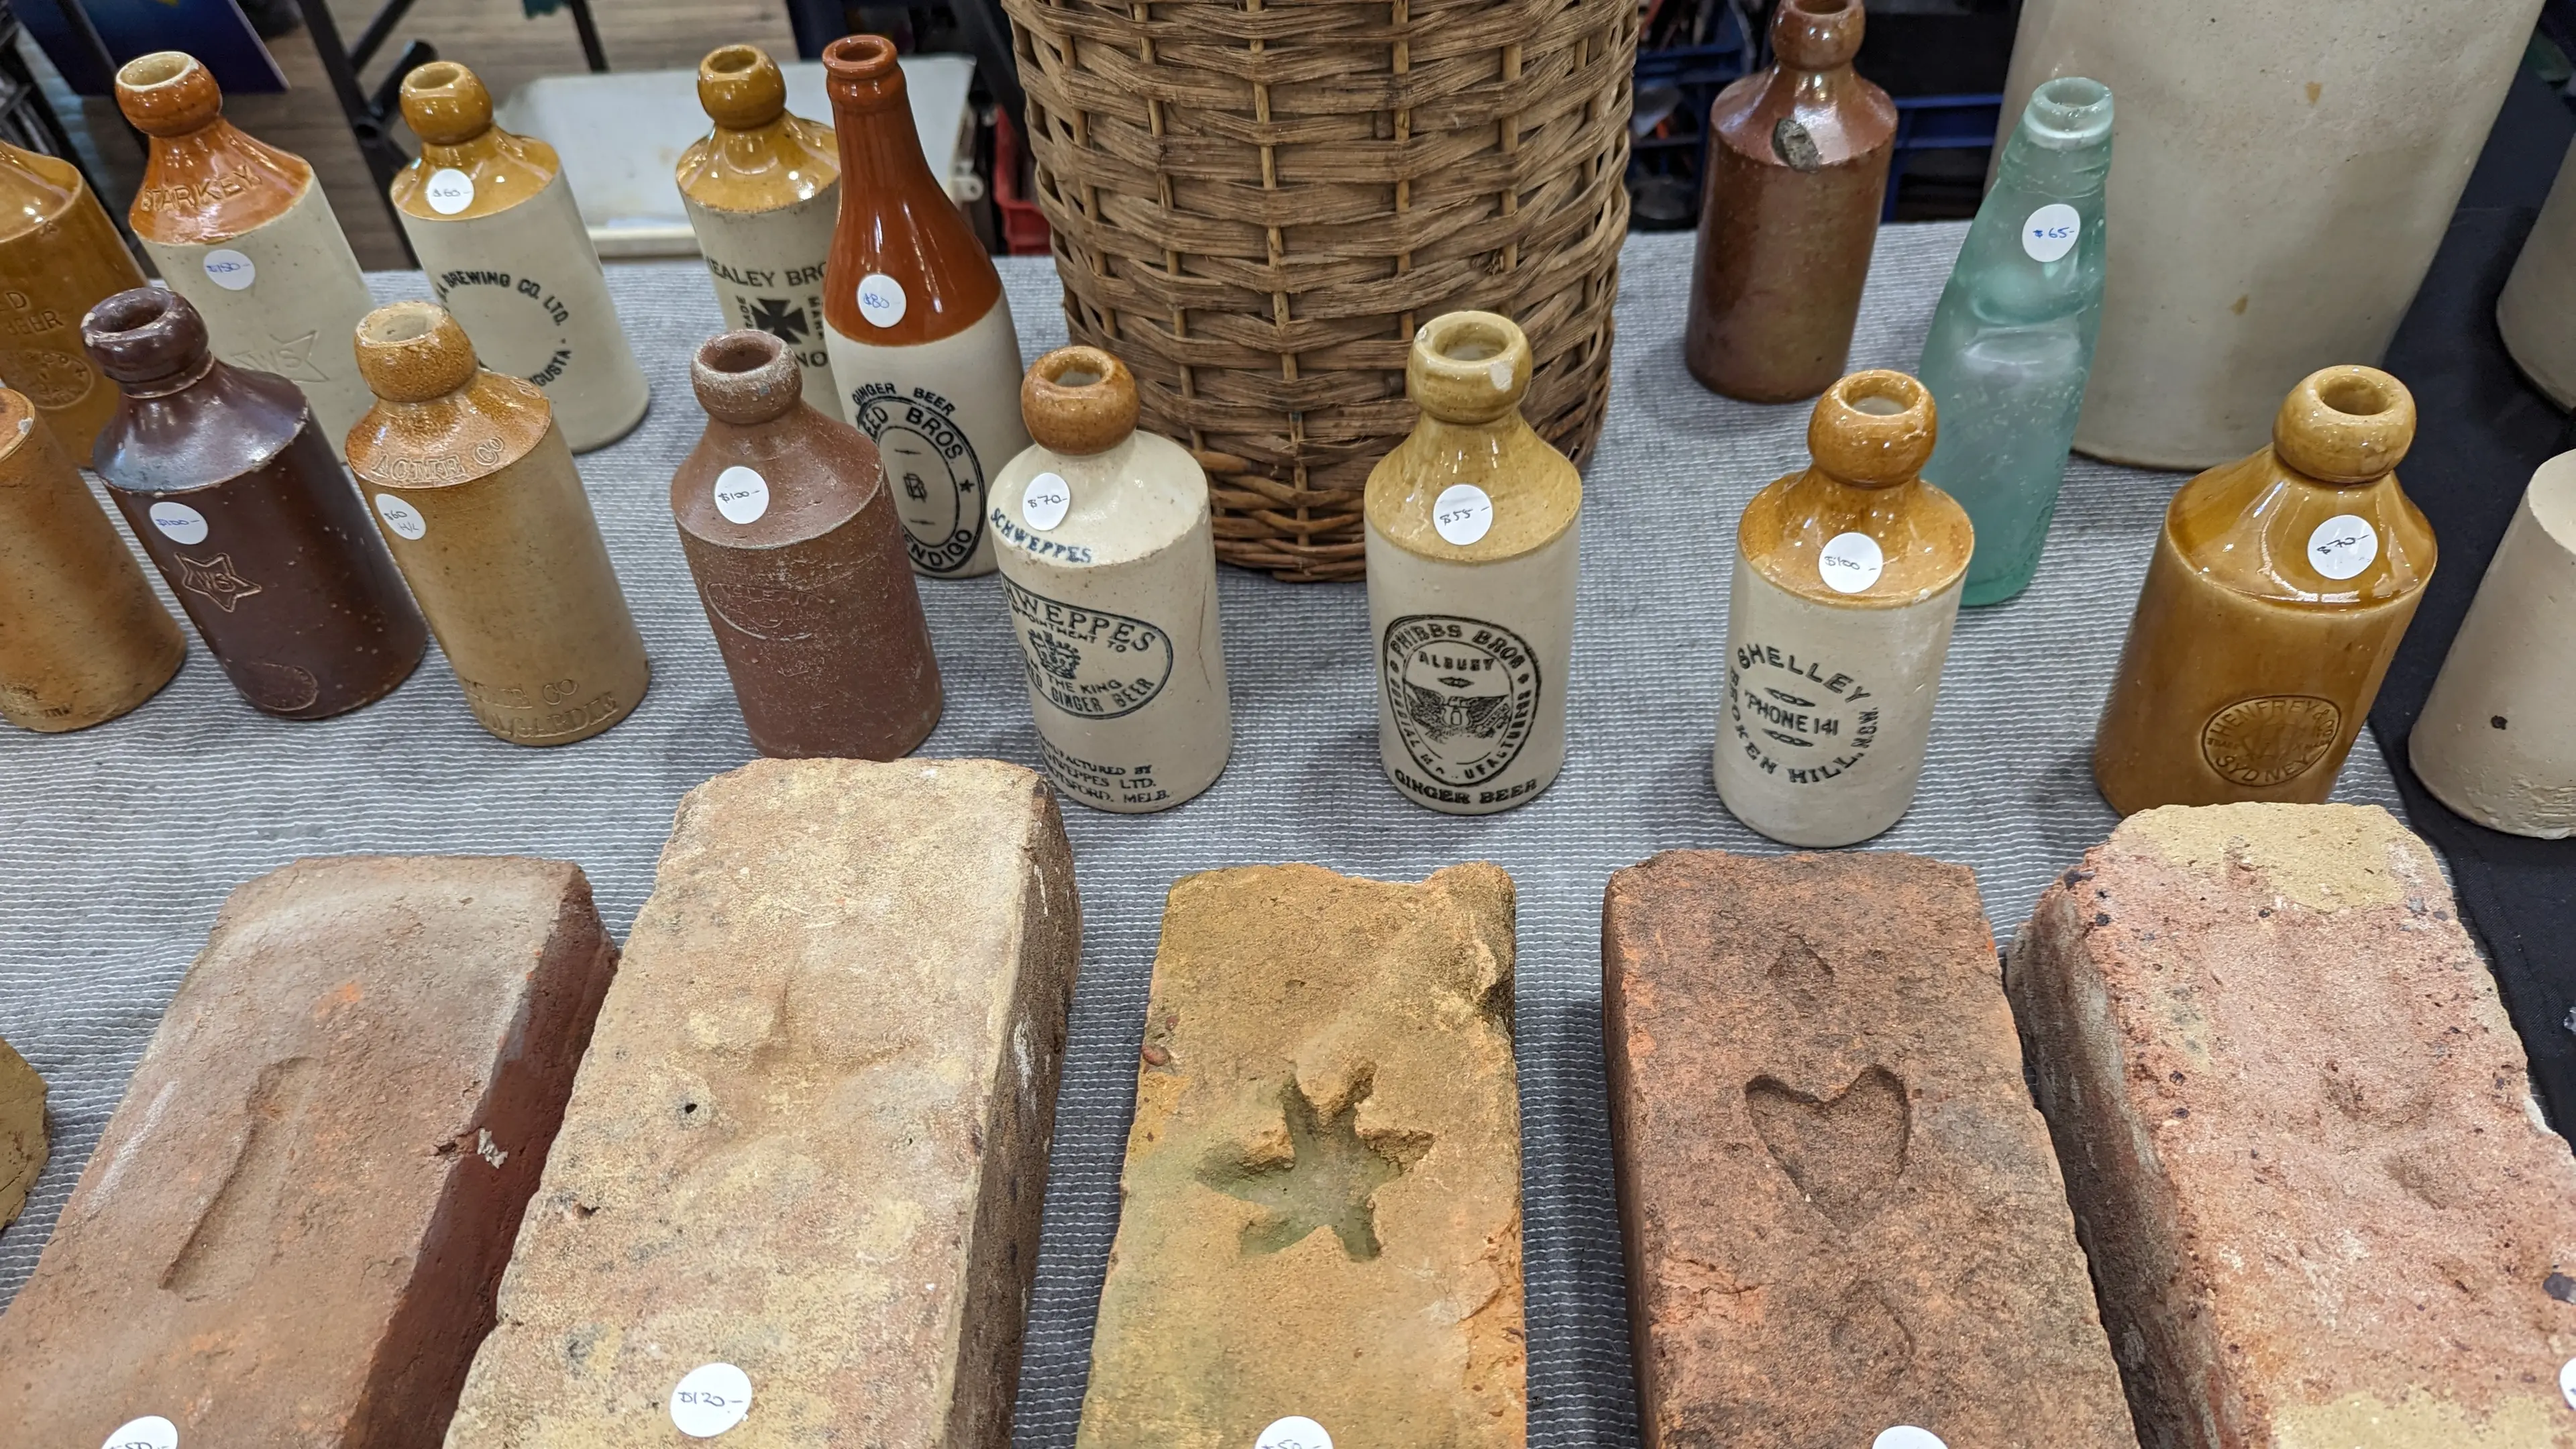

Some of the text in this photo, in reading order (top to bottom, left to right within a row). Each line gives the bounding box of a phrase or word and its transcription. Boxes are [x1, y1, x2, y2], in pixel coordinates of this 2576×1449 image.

[441, 270, 512, 288] BREWING
[735, 294, 754, 329] RADE
[528, 349, 572, 387] GUSTA
[852, 382, 956, 417] GINGER BEER
[863, 406, 889, 444] EED
[904, 529, 973, 568] ENDIGO
[990, 507, 1093, 564] SCHWEPPES
[1004, 581, 1157, 653] HWEPPES
[1106, 639, 1127, 653] TO
[1389, 622, 1463, 659] PHIBBS
[1046, 672, 1075, 694] THE
[1079, 678, 1123, 695] KING
[1736, 643, 1872, 704] SHELLEY
[1050, 677, 1156, 713] GINGER BEER
[1729, 665, 1778, 775] BROKEN
[1813, 717, 1839, 737] 141
[2209, 699, 2318, 737] HENFREY
[1040, 739, 1157, 790] CHWEPPES LTD.
[1134, 764, 1153, 775] BY
[2215, 754, 2310, 783] SYDNEY
[1393, 768, 1538, 804] GINGER BEER
